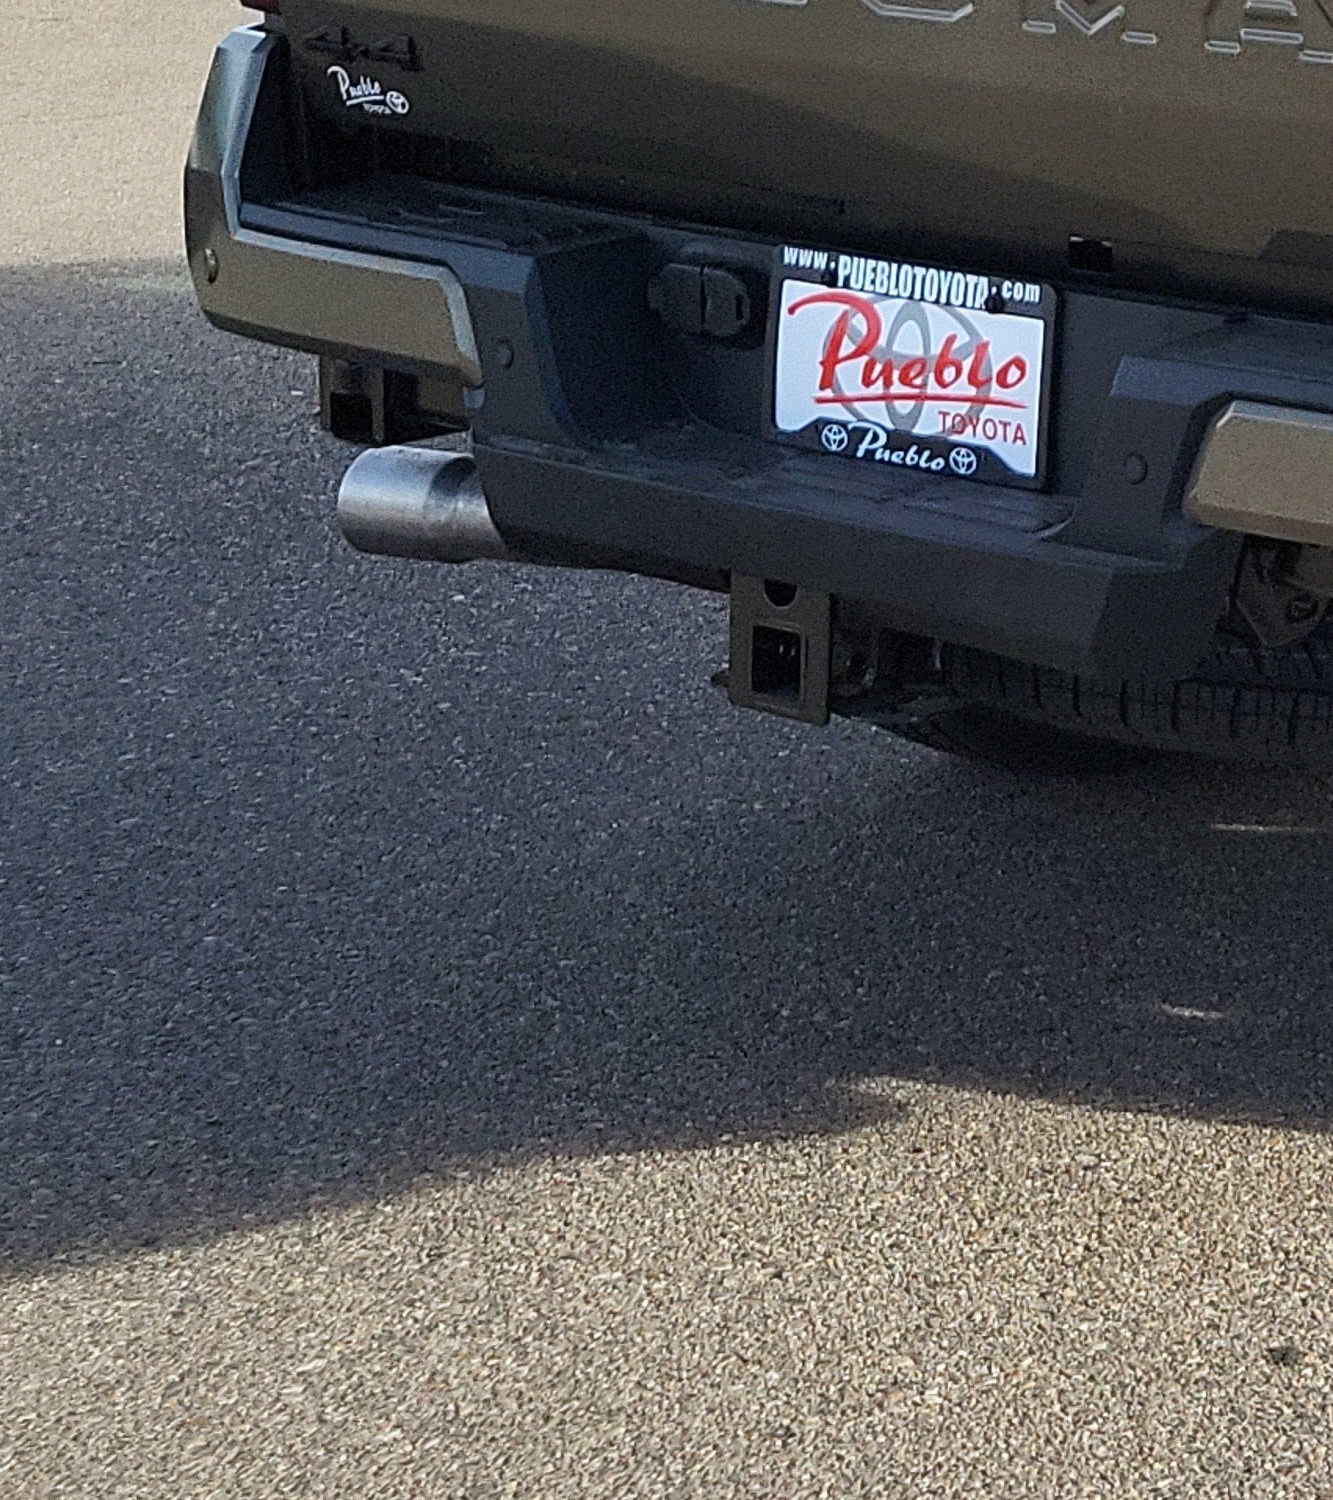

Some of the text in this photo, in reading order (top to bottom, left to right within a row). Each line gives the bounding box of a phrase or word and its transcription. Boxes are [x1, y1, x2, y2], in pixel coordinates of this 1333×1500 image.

[787, 290, 1028, 391] Pueblo
[847, 421, 947, 472] Pueblo
[937, 410, 1029, 446] TOYOTA
